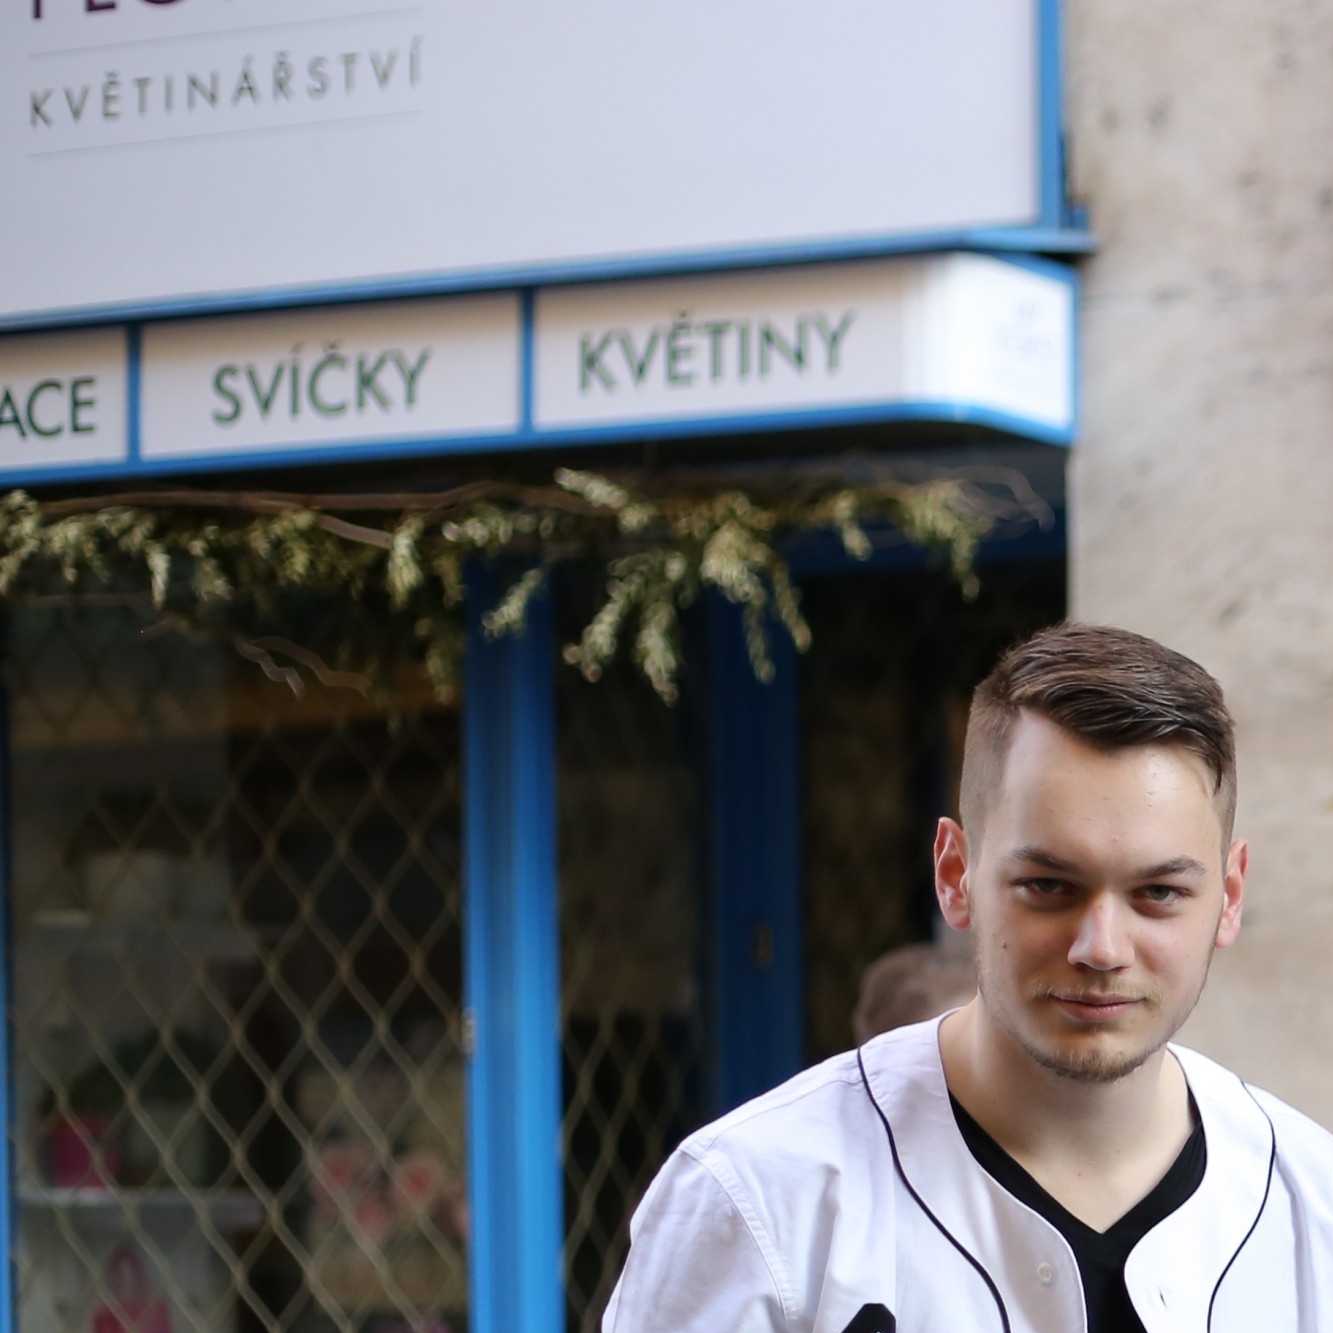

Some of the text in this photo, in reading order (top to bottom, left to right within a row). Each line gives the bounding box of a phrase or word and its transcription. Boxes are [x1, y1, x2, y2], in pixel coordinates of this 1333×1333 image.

[29, 34, 425, 128] KVĚTINÁŘSTVÍ
[0, 309, 856, 438] ACE SVÍČKY KVĚTINY
